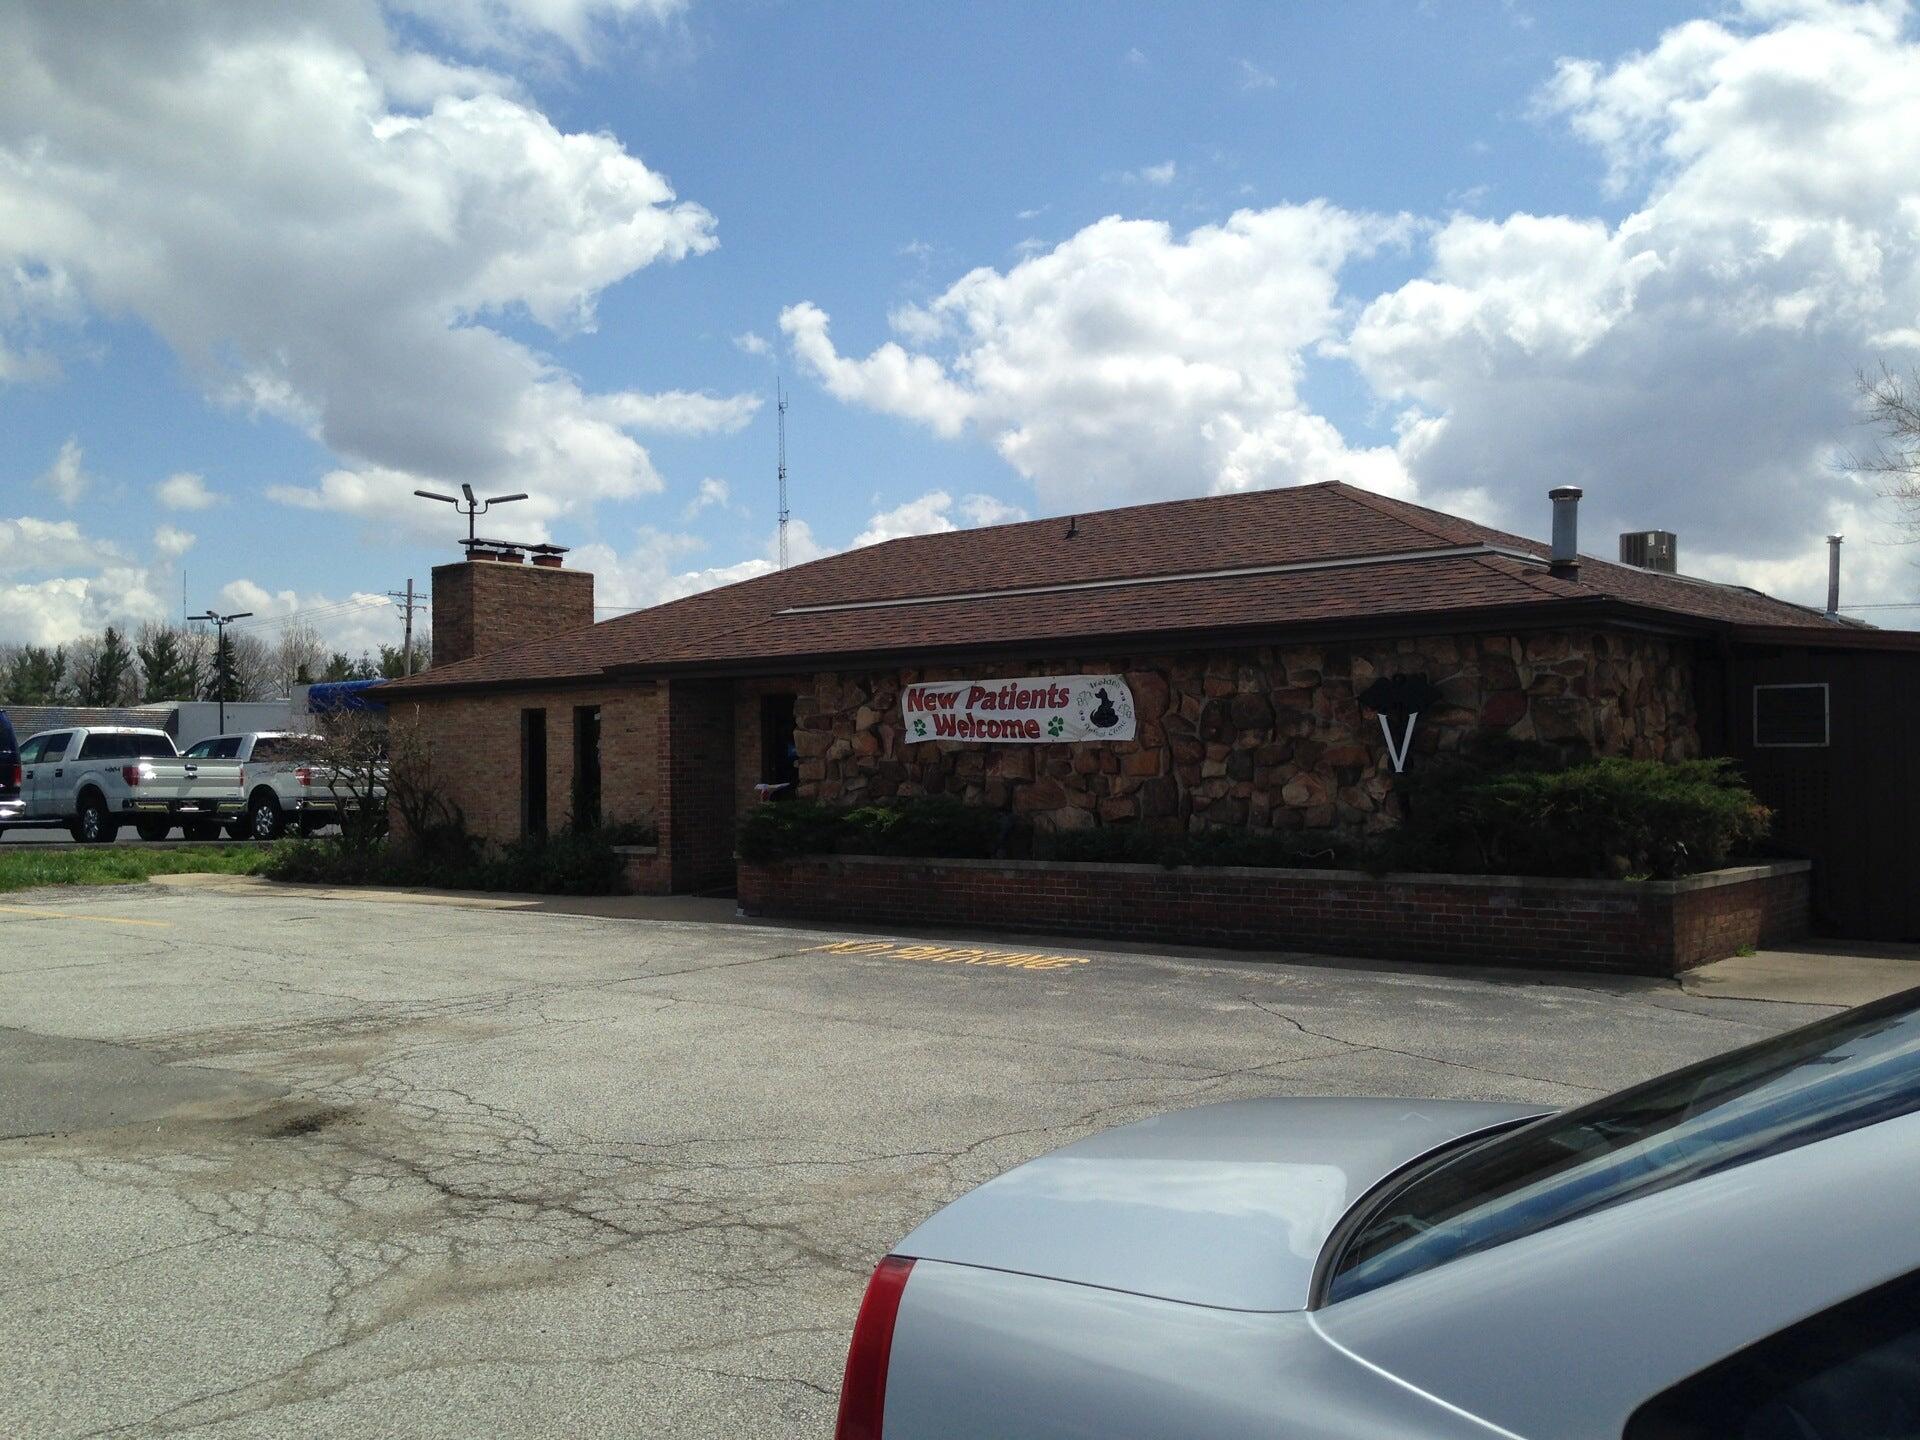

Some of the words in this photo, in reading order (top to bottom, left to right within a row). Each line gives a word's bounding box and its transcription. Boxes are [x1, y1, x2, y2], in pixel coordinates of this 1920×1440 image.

[907, 687, 959, 712] New
[965, 682, 1070, 710] Patients
[932, 712, 1041, 739] Welcome
[866, 946, 1091, 970] PARKING
